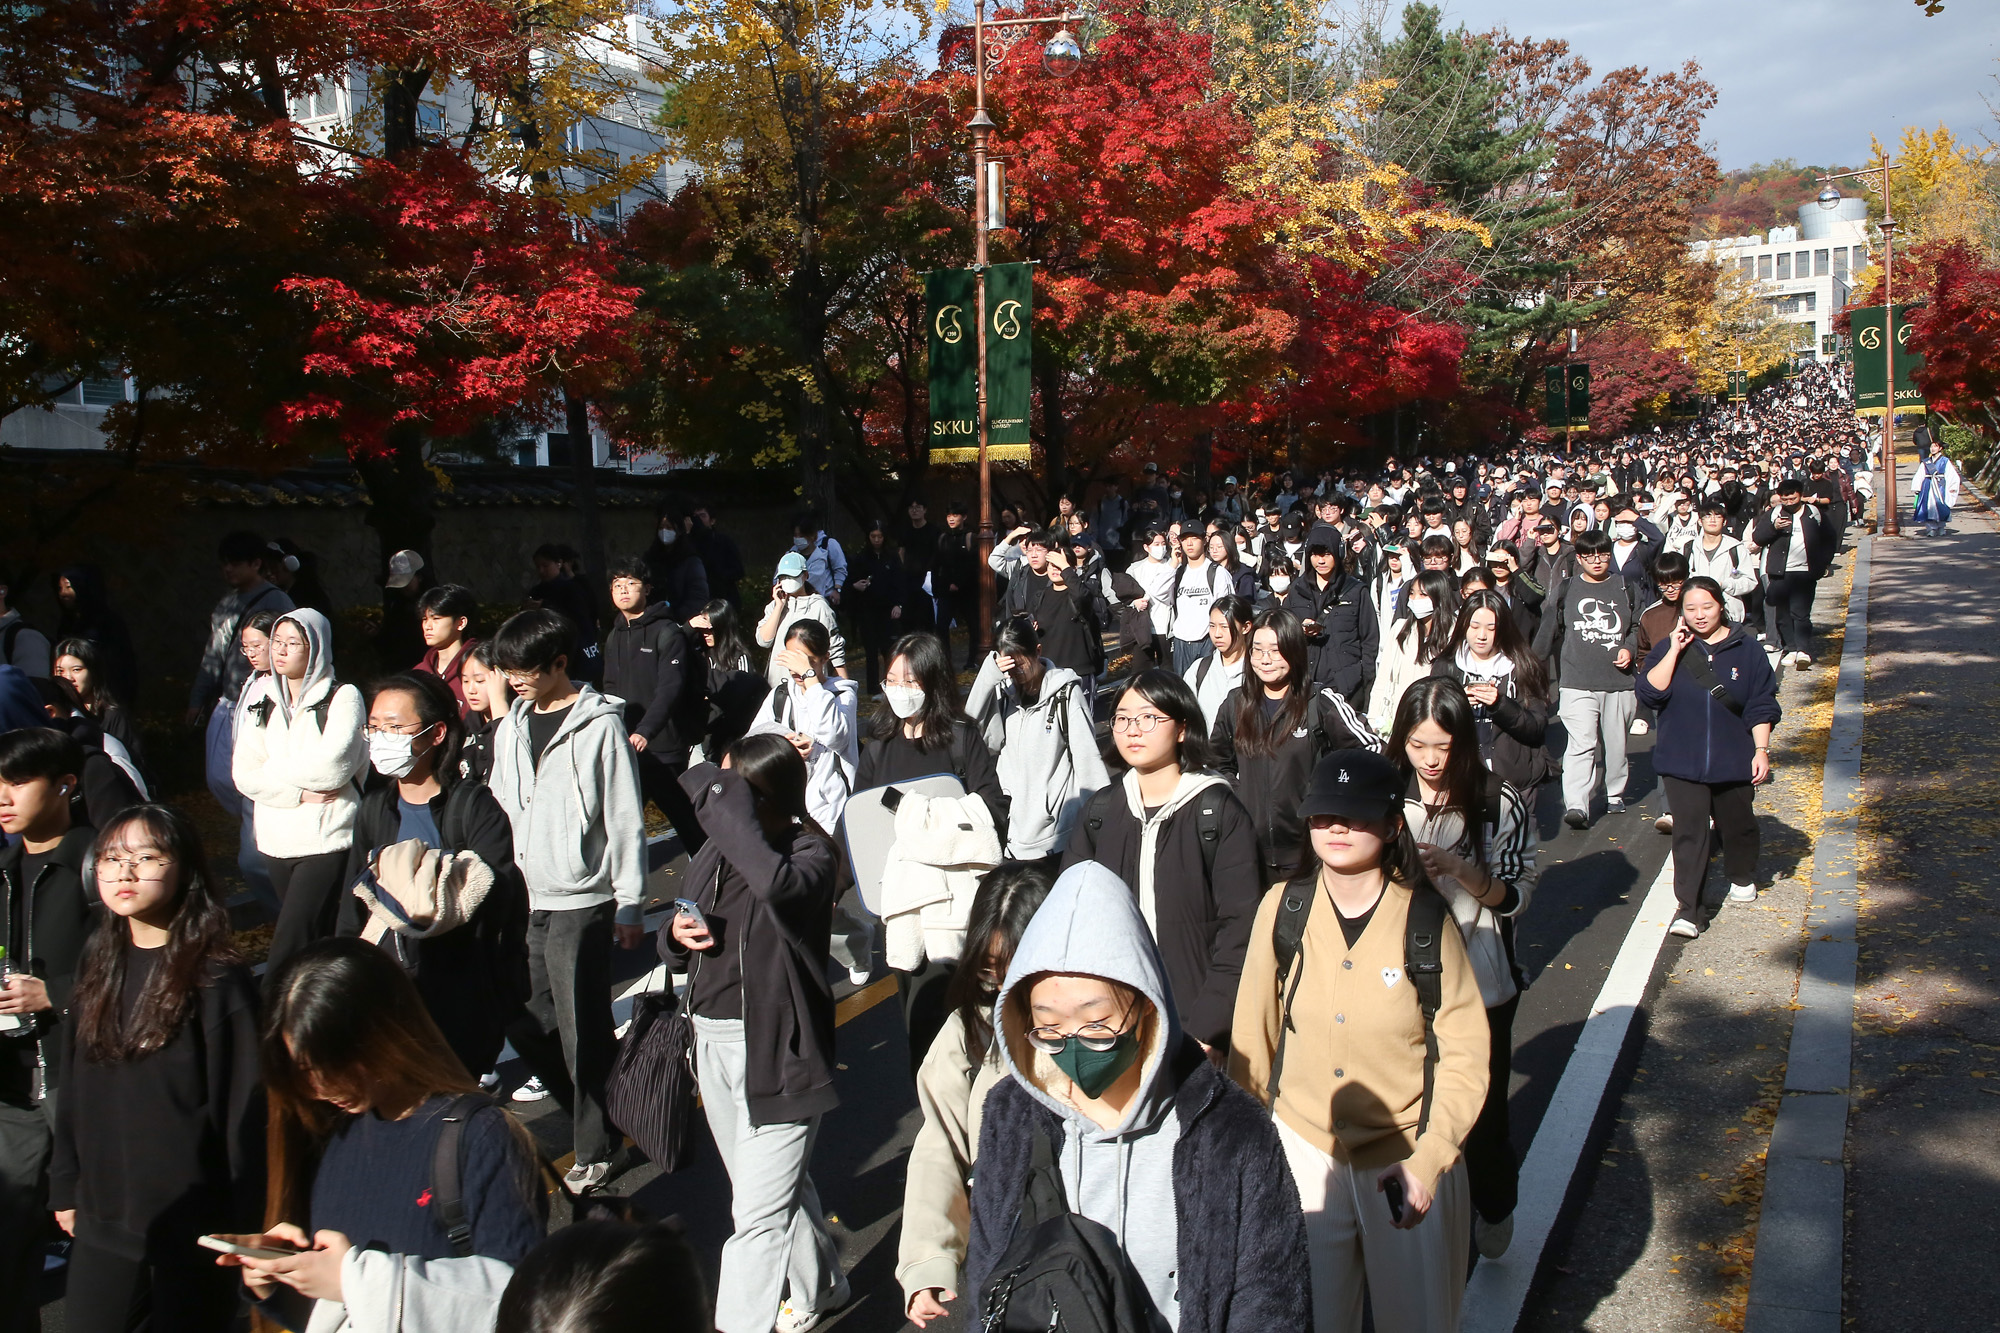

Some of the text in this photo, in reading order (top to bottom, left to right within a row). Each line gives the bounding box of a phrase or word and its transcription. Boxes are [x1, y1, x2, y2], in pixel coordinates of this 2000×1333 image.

[1893, 389, 1922, 400] SKKU
[933, 420, 973, 436] SKKU
[1337, 768, 1350, 783] LA
